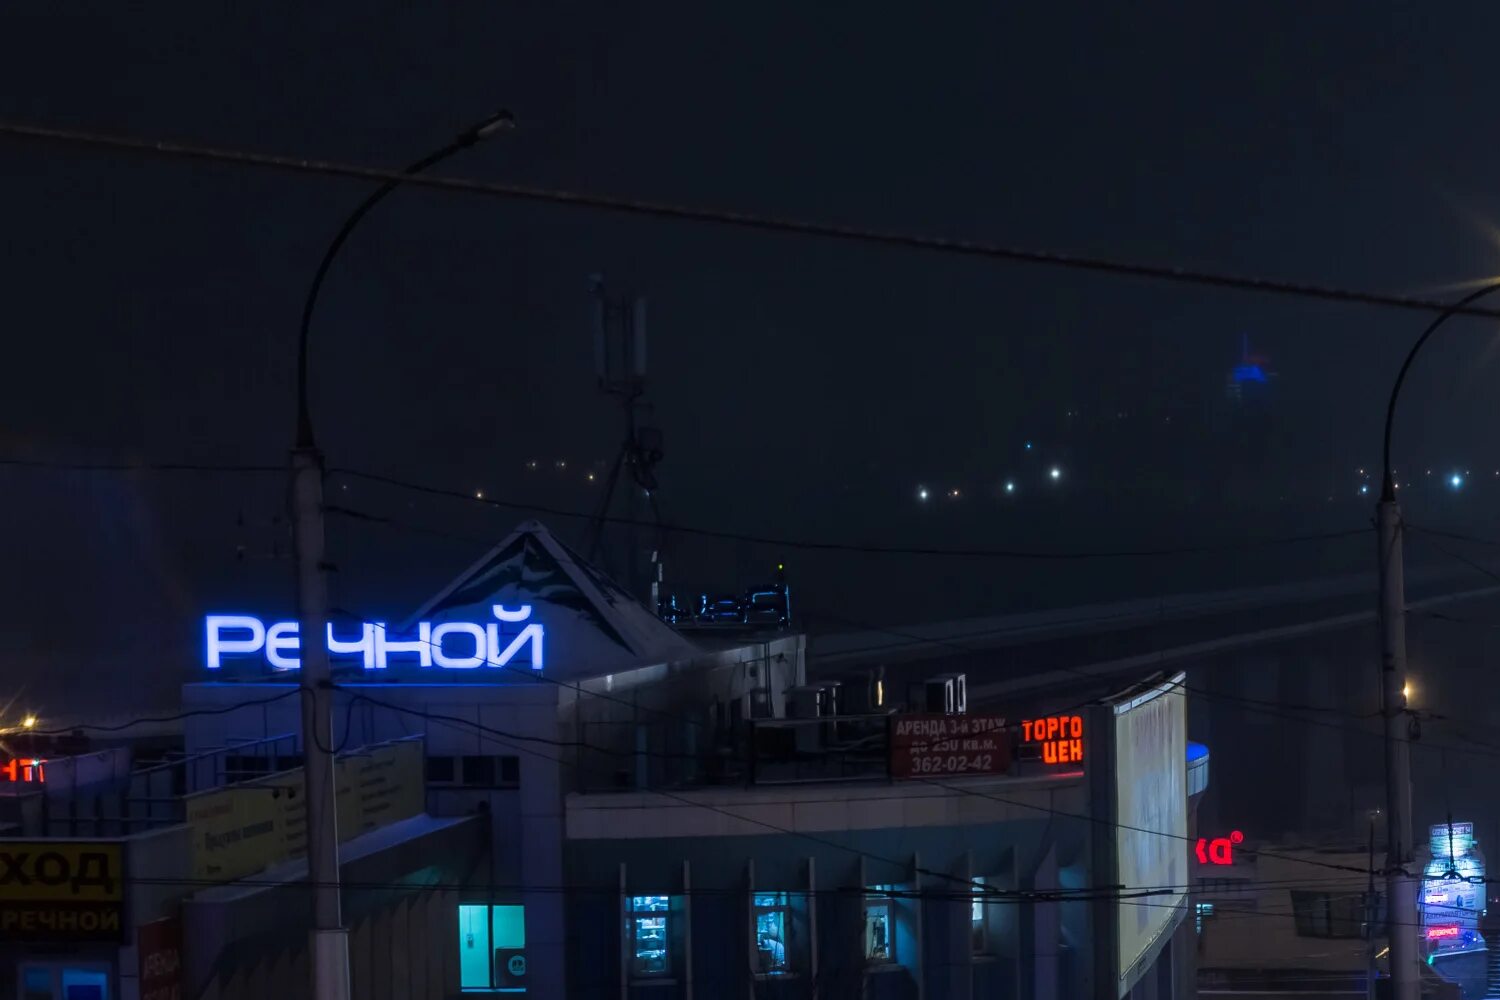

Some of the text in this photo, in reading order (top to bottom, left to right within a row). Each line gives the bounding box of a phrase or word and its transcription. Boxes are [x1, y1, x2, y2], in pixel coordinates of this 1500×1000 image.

[896, 719, 946, 737] АРЕНДА
[971, 717, 1007, 734] ЭТАЖ
[911, 755, 993, 773] 362-02-42
[1, 907, 120, 931] РЕЧНОЙ
